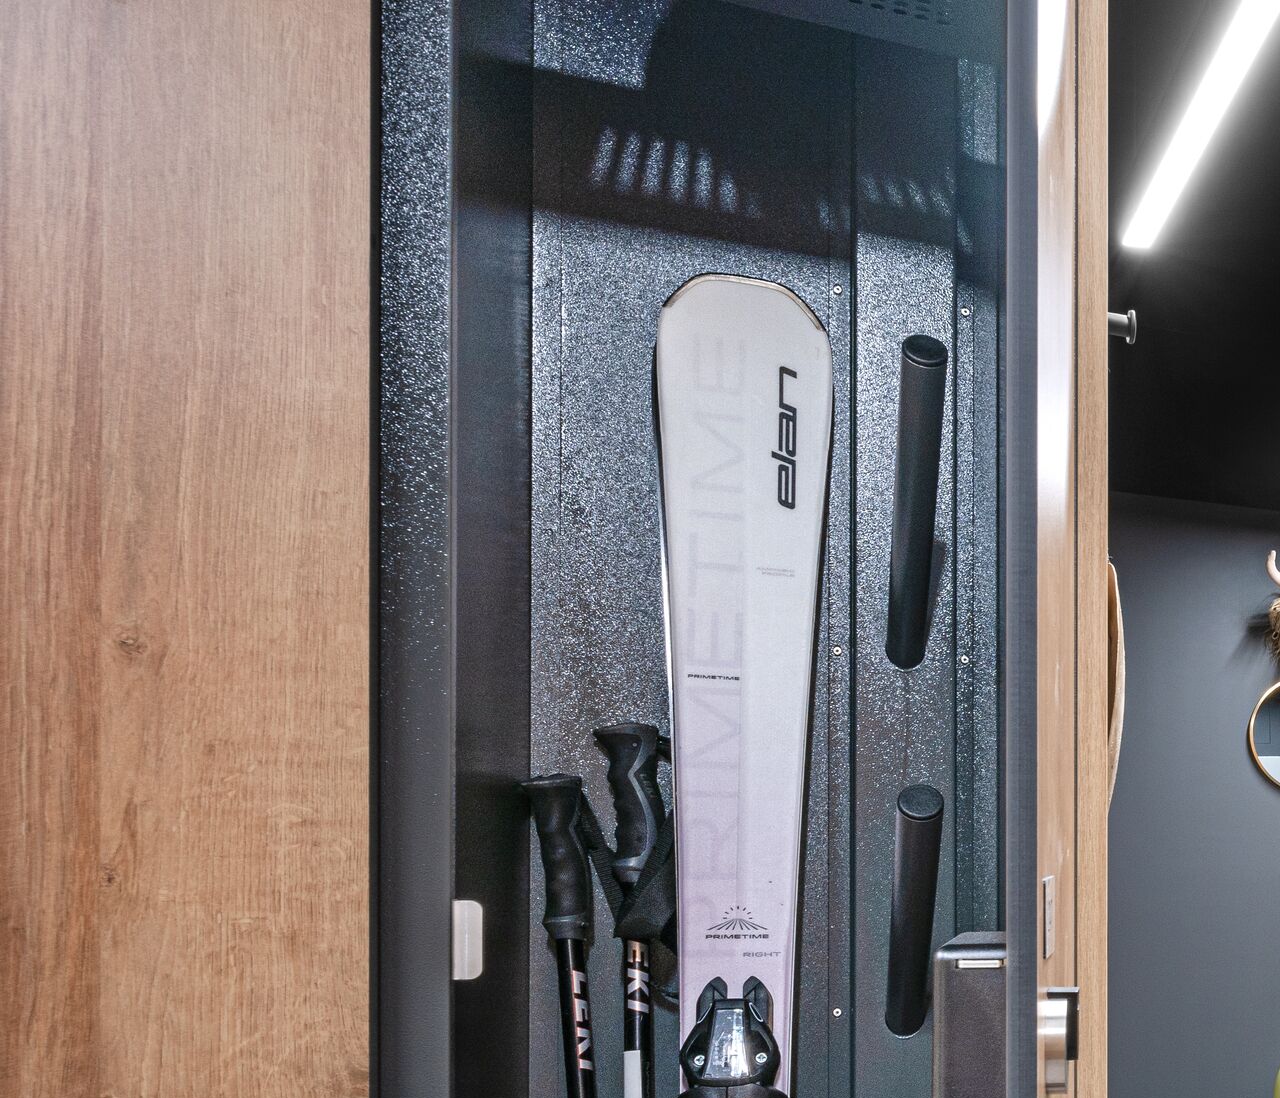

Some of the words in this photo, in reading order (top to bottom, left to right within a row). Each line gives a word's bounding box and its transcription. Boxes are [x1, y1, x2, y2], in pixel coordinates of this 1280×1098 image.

[771, 366, 797, 510] elan
[687, 673, 740, 681] PRIMETIME
[572, 969, 593, 1071] LEKI
[627, 940, 649, 1013] EKI
